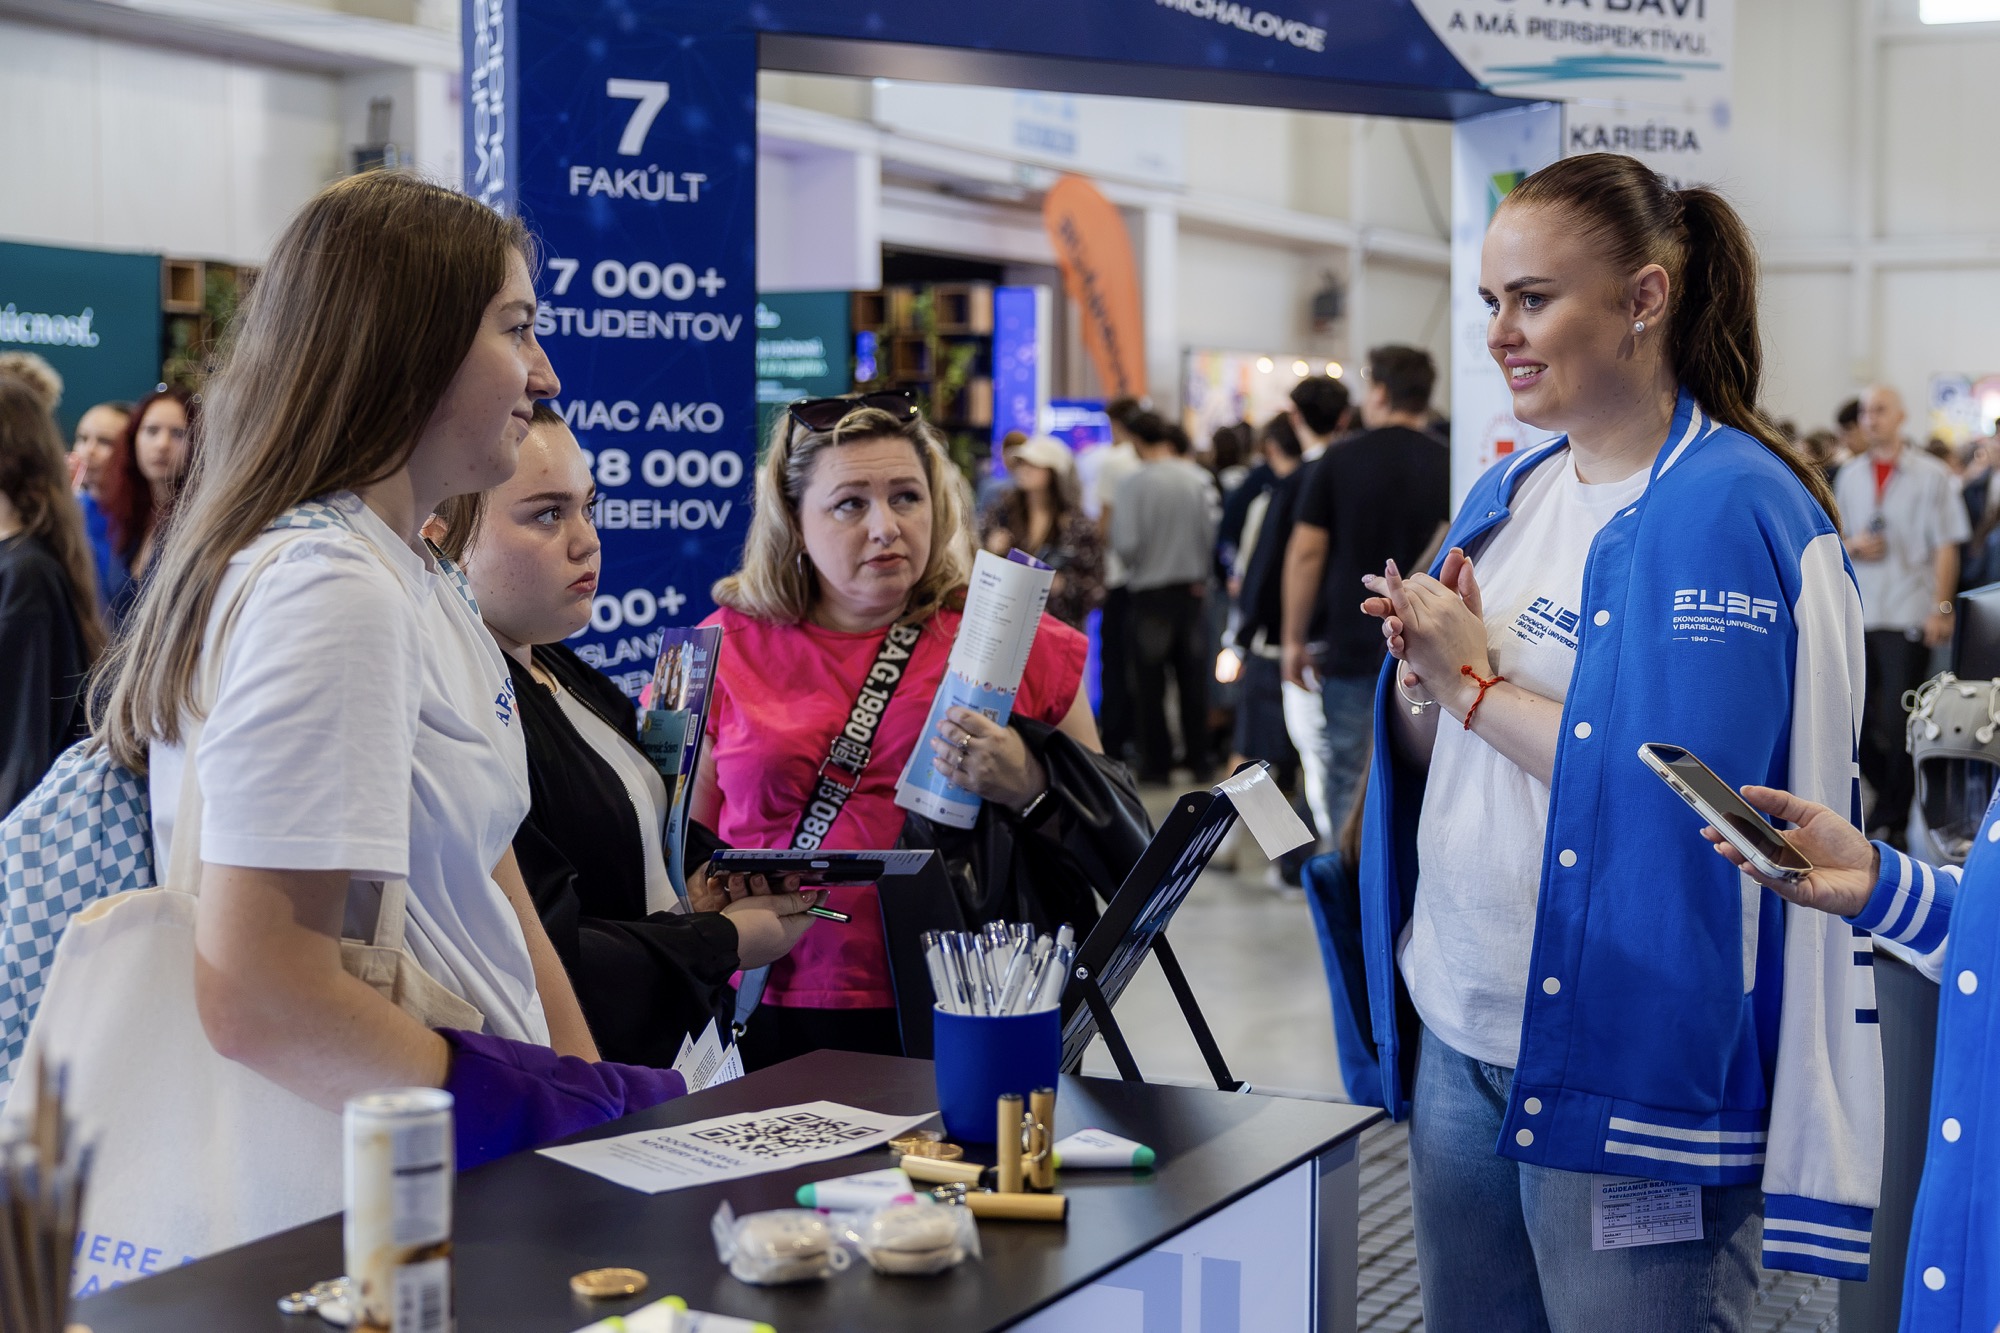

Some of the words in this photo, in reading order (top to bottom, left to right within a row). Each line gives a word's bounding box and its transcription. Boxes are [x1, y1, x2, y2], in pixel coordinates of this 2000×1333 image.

[1450, 11, 1467, 32] A
[606, 77, 670, 156] 7
[1569, 119, 1701, 152] KARIÉRA
[568, 164, 708, 203] FAKÚLT
[548, 258, 580, 296] 7
[592, 260, 726, 301] 000+
[534, 301, 742, 342] ŠTUDENTOV
[551, 399, 641, 432] VIAC
[645, 402, 725, 433] AKO
[641, 449, 744, 488] 000
[594, 494, 733, 530] ÍBEHOV
[569, 585, 687, 638] 00+
[1673, 616, 1725, 625] EKONOMICKÁ
[1726, 620, 1768, 635] UNIVERZITA
[1679, 624, 1725, 633] BRATISLAVE
[792, 800, 838, 851] 980
[1602, 1183, 1648, 1194] GAUDEAMUS
